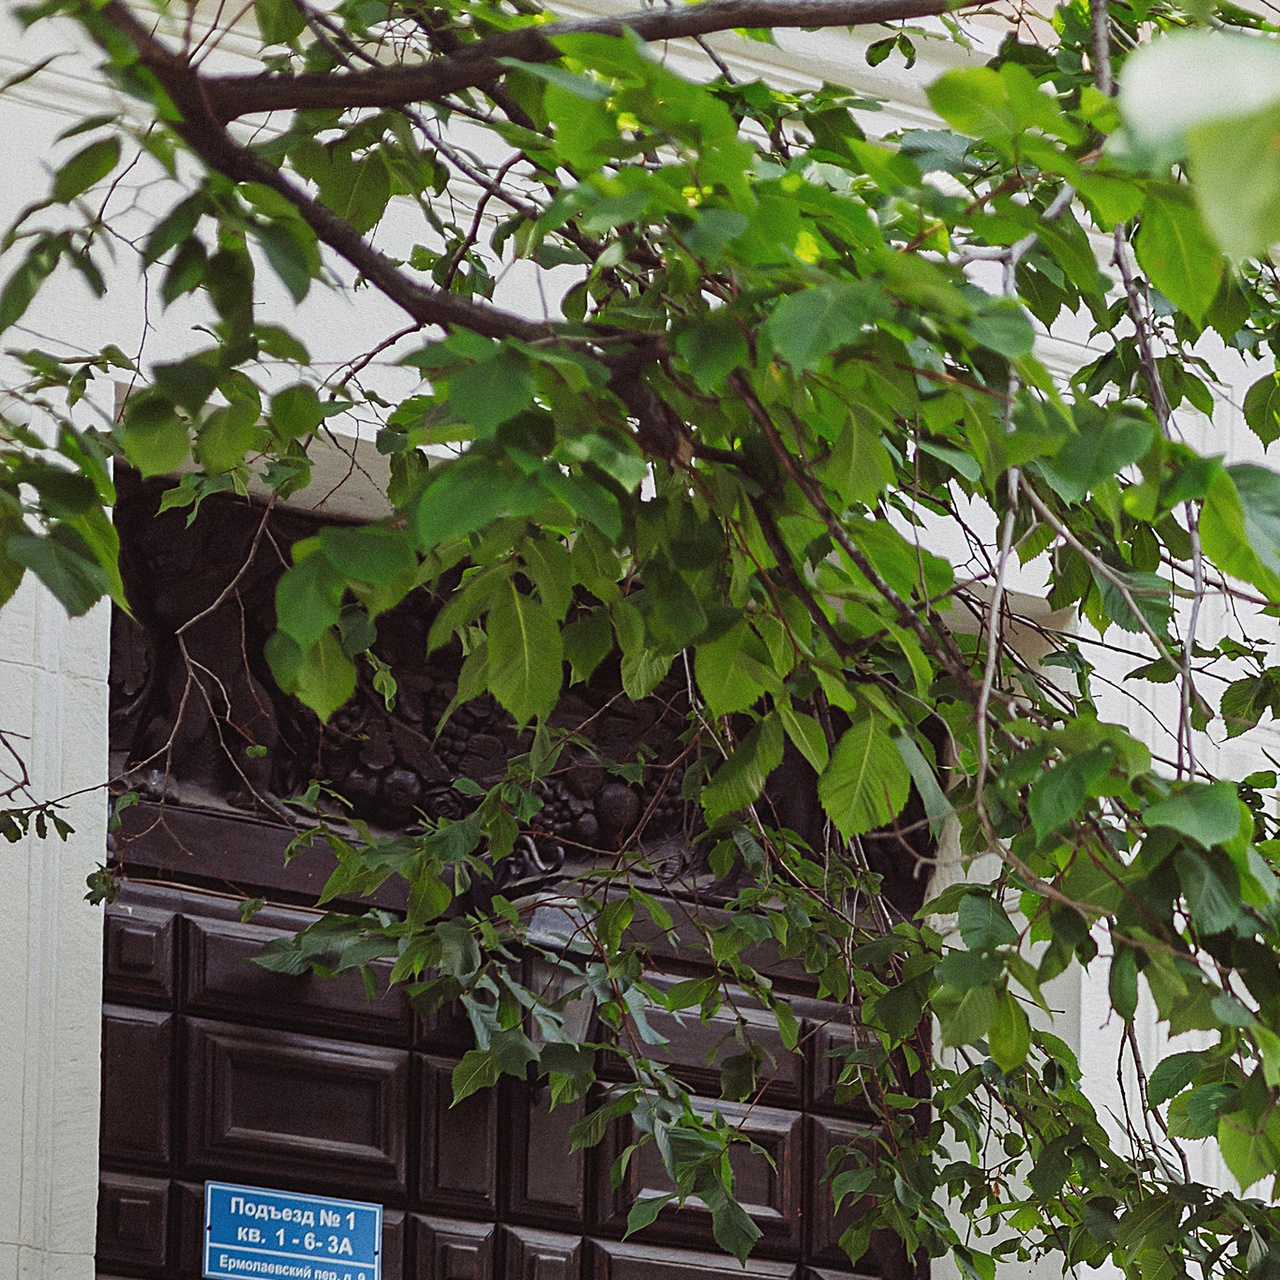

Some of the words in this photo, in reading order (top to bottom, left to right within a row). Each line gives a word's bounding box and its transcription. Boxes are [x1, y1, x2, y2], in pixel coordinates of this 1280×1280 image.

[230, 1197, 315, 1226] Подъезд
[319, 1209, 341, 1228] №
[346, 1211, 355, 1230] 1
[237, 1226, 266, 1244] кв.
[275, 1228, 285, 1246] 1
[219, 1254, 312, 1279] Ермолаевский
